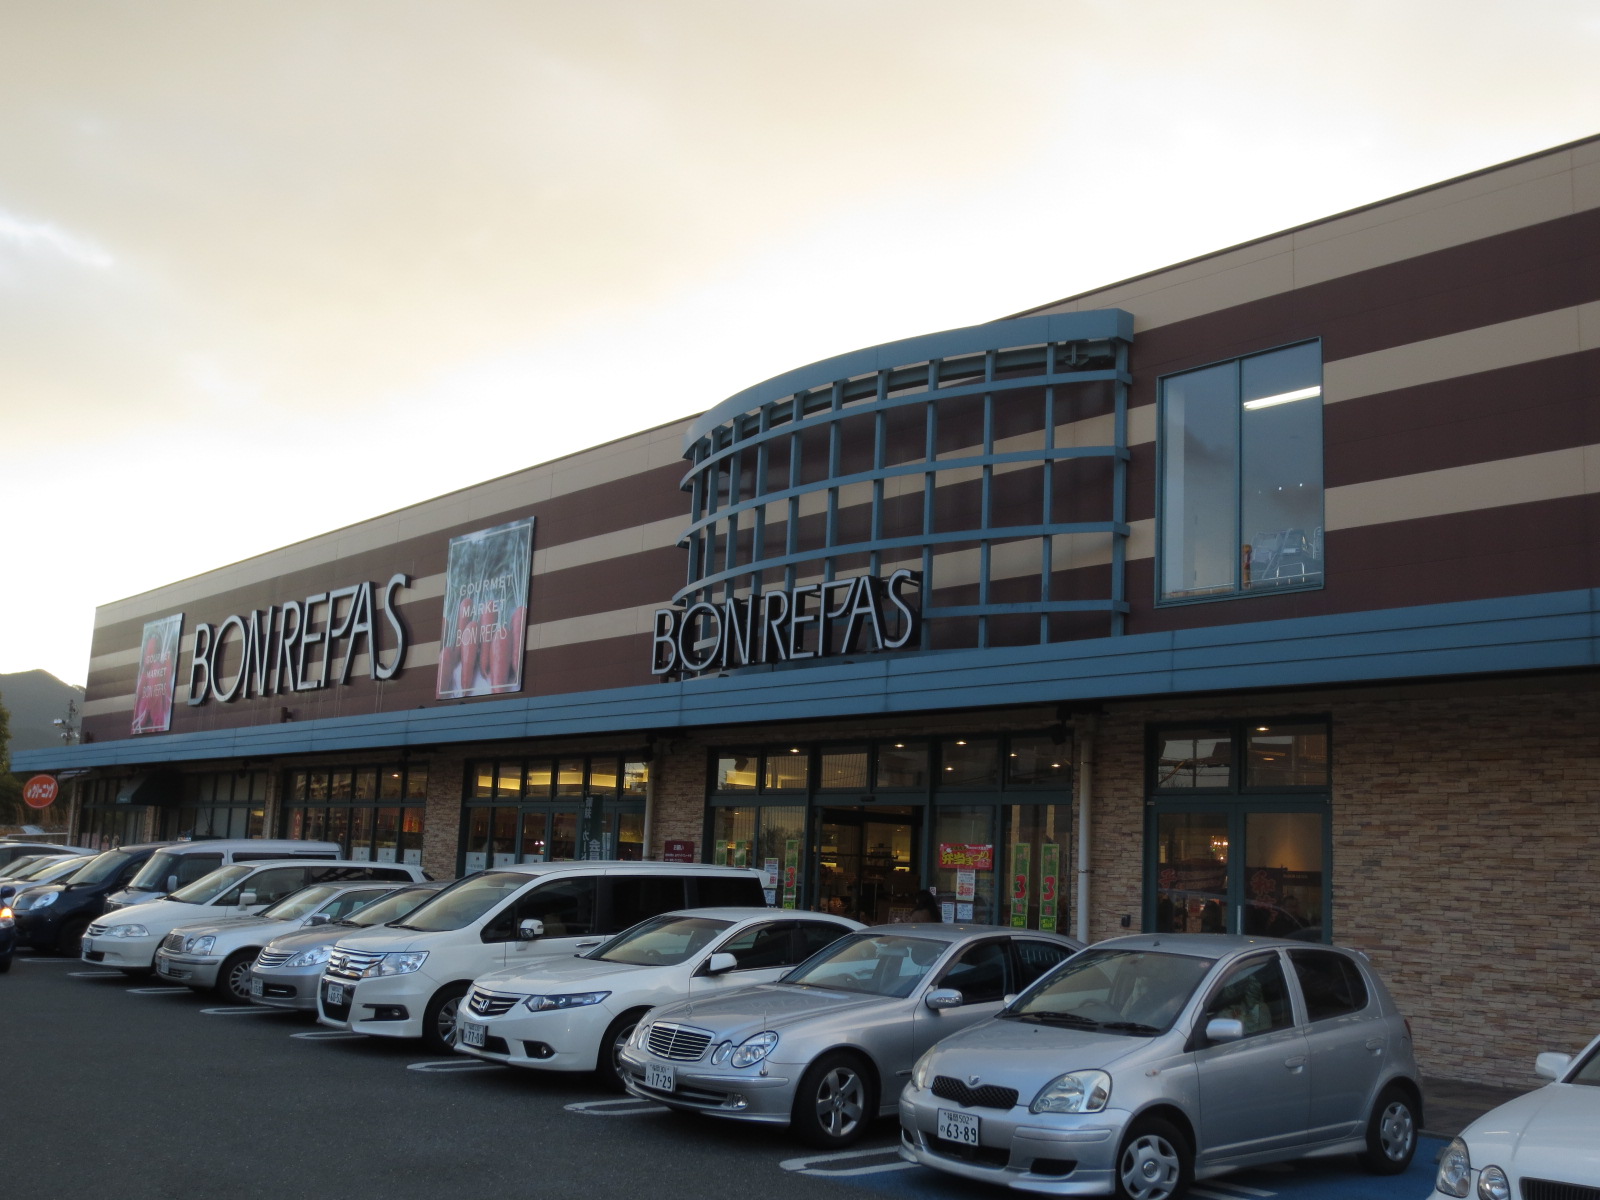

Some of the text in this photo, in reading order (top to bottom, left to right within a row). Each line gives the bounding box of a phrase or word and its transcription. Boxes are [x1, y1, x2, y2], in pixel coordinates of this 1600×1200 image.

[459, 574, 513, 596] GOURMET
[461, 599, 507, 618] MARKET
[456, 621, 508, 647] BON REPAS
[146, 651, 171, 664] GOURMET
[146, 667, 167, 679] MARKET
[651, 1072, 672, 1090] 17-29
[946, 1122, 977, 1143] 63-89
